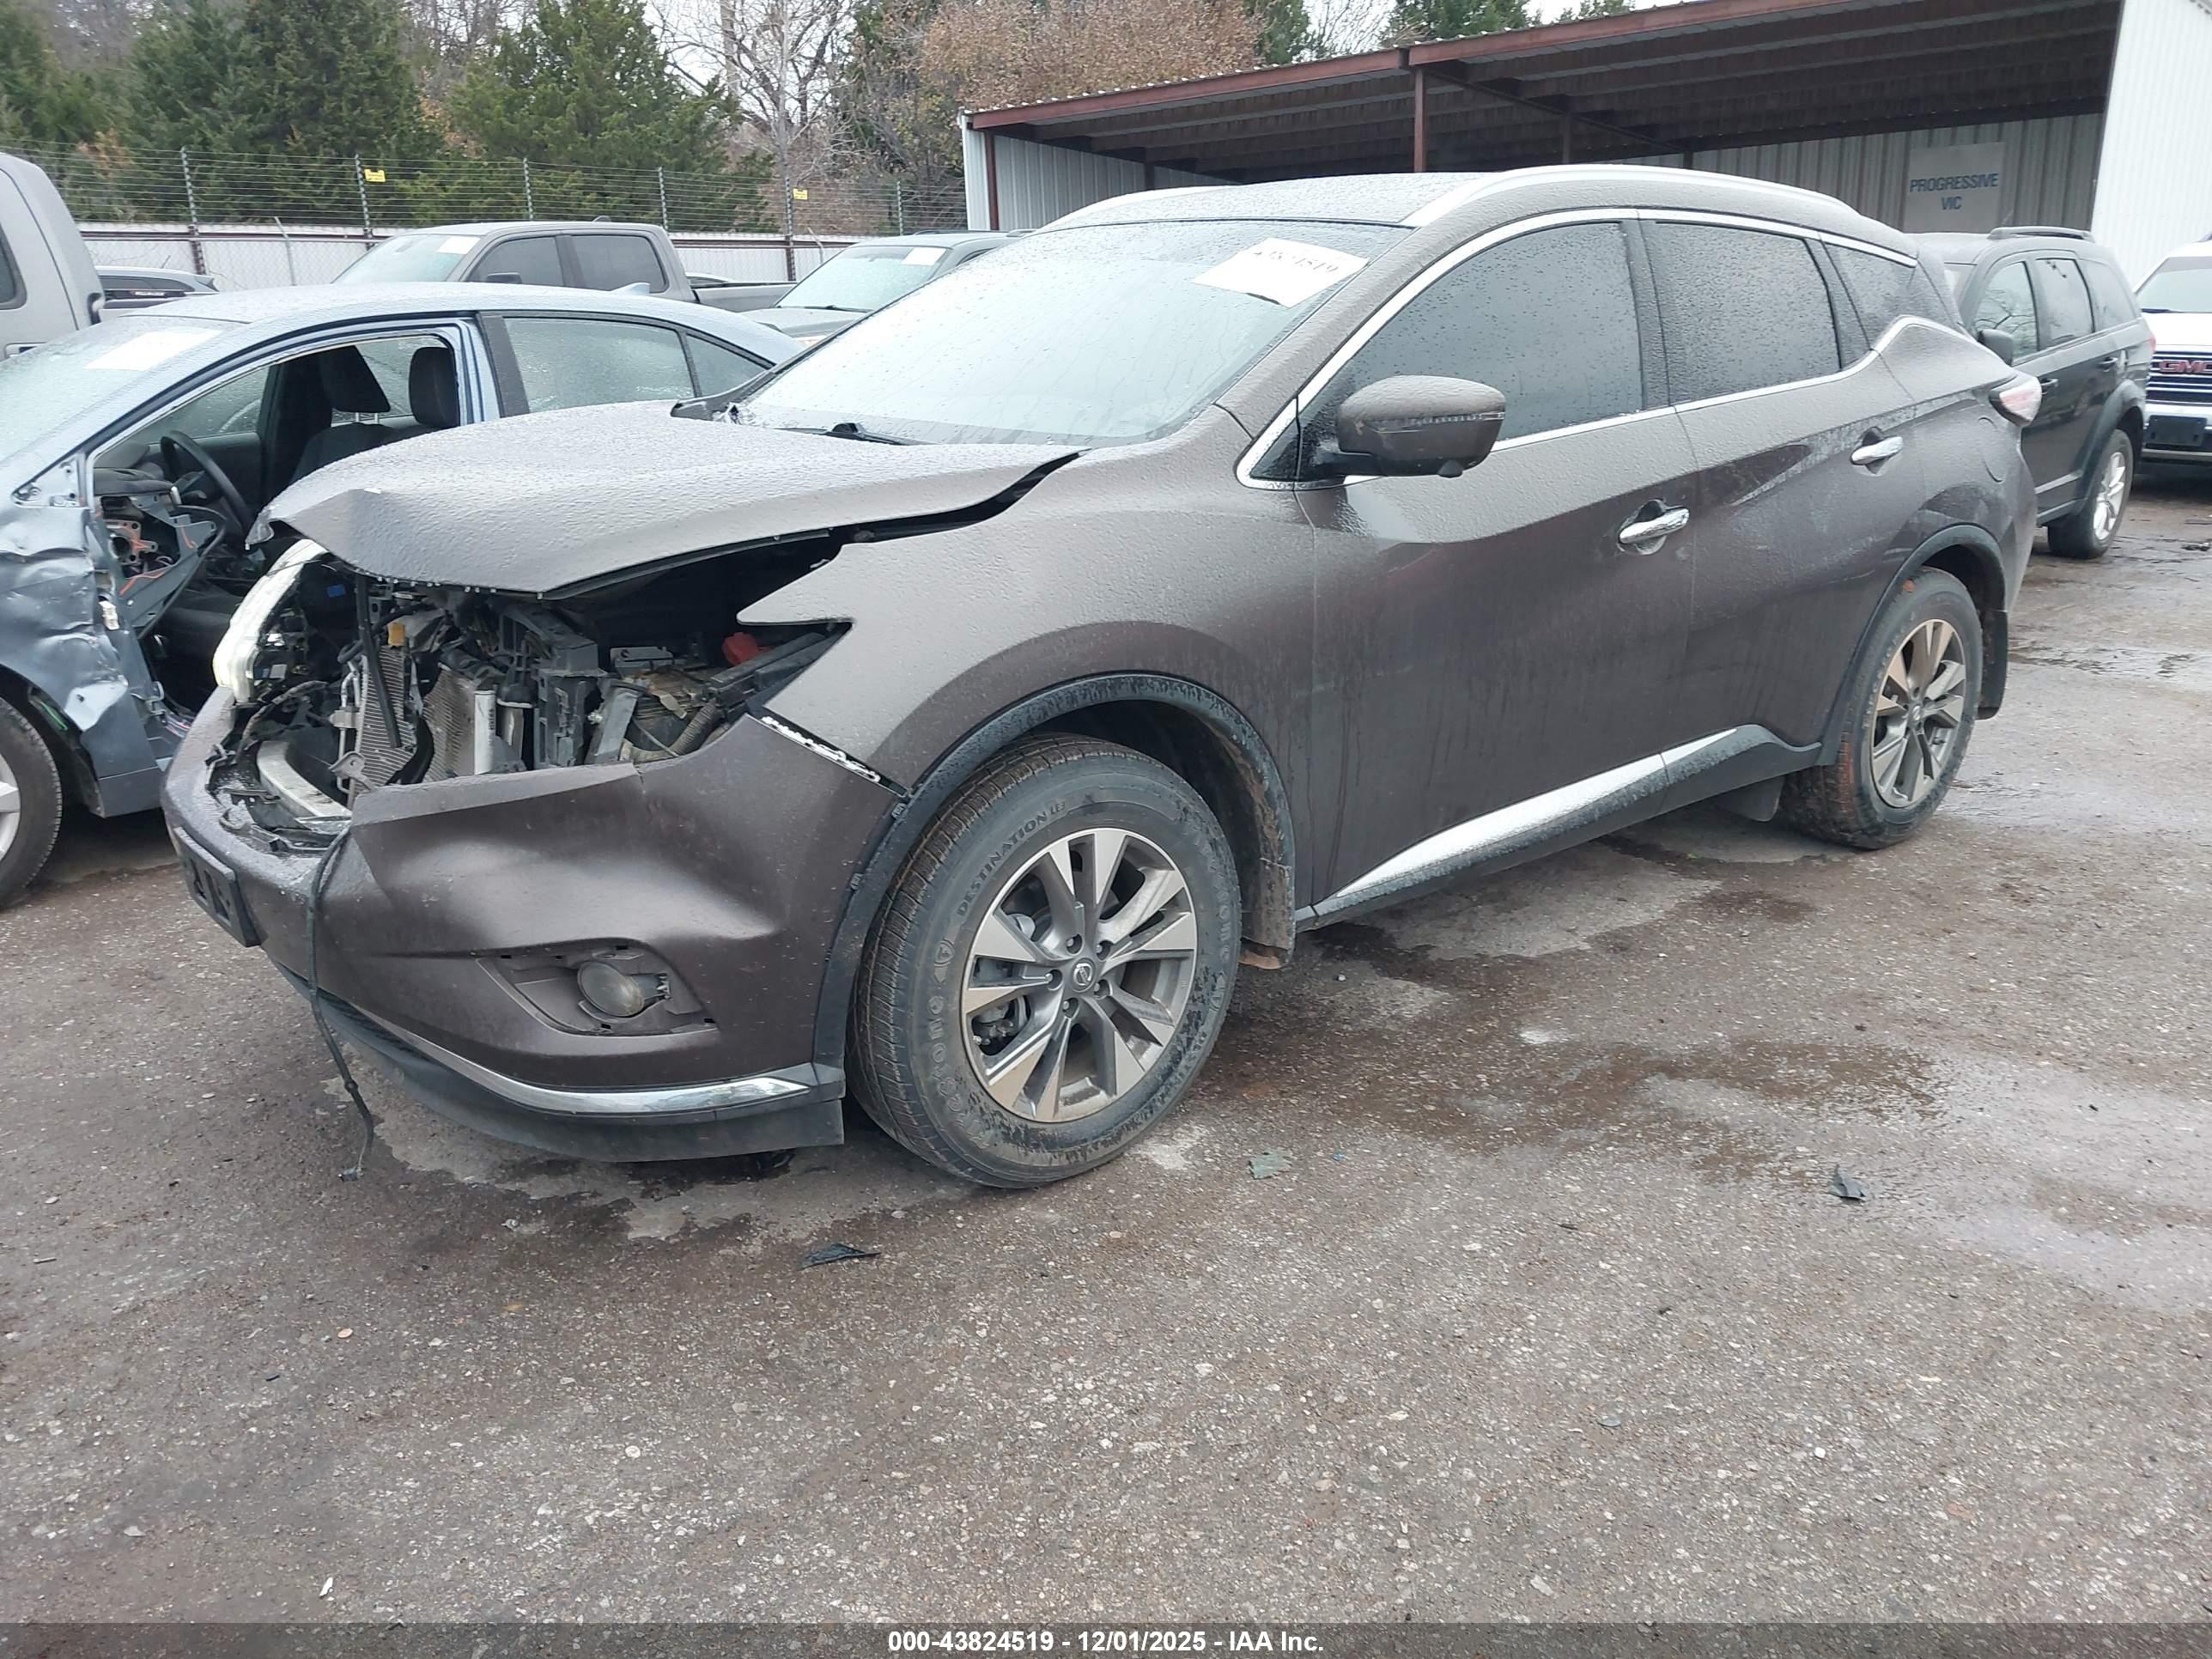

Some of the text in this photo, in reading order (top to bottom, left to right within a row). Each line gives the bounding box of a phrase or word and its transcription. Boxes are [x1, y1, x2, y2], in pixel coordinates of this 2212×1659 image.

[1909, 173, 1999, 192] PROGRESSIVE
[1941, 196, 1962, 210] VIC
[957, 811, 1047, 916] DESTINATION
